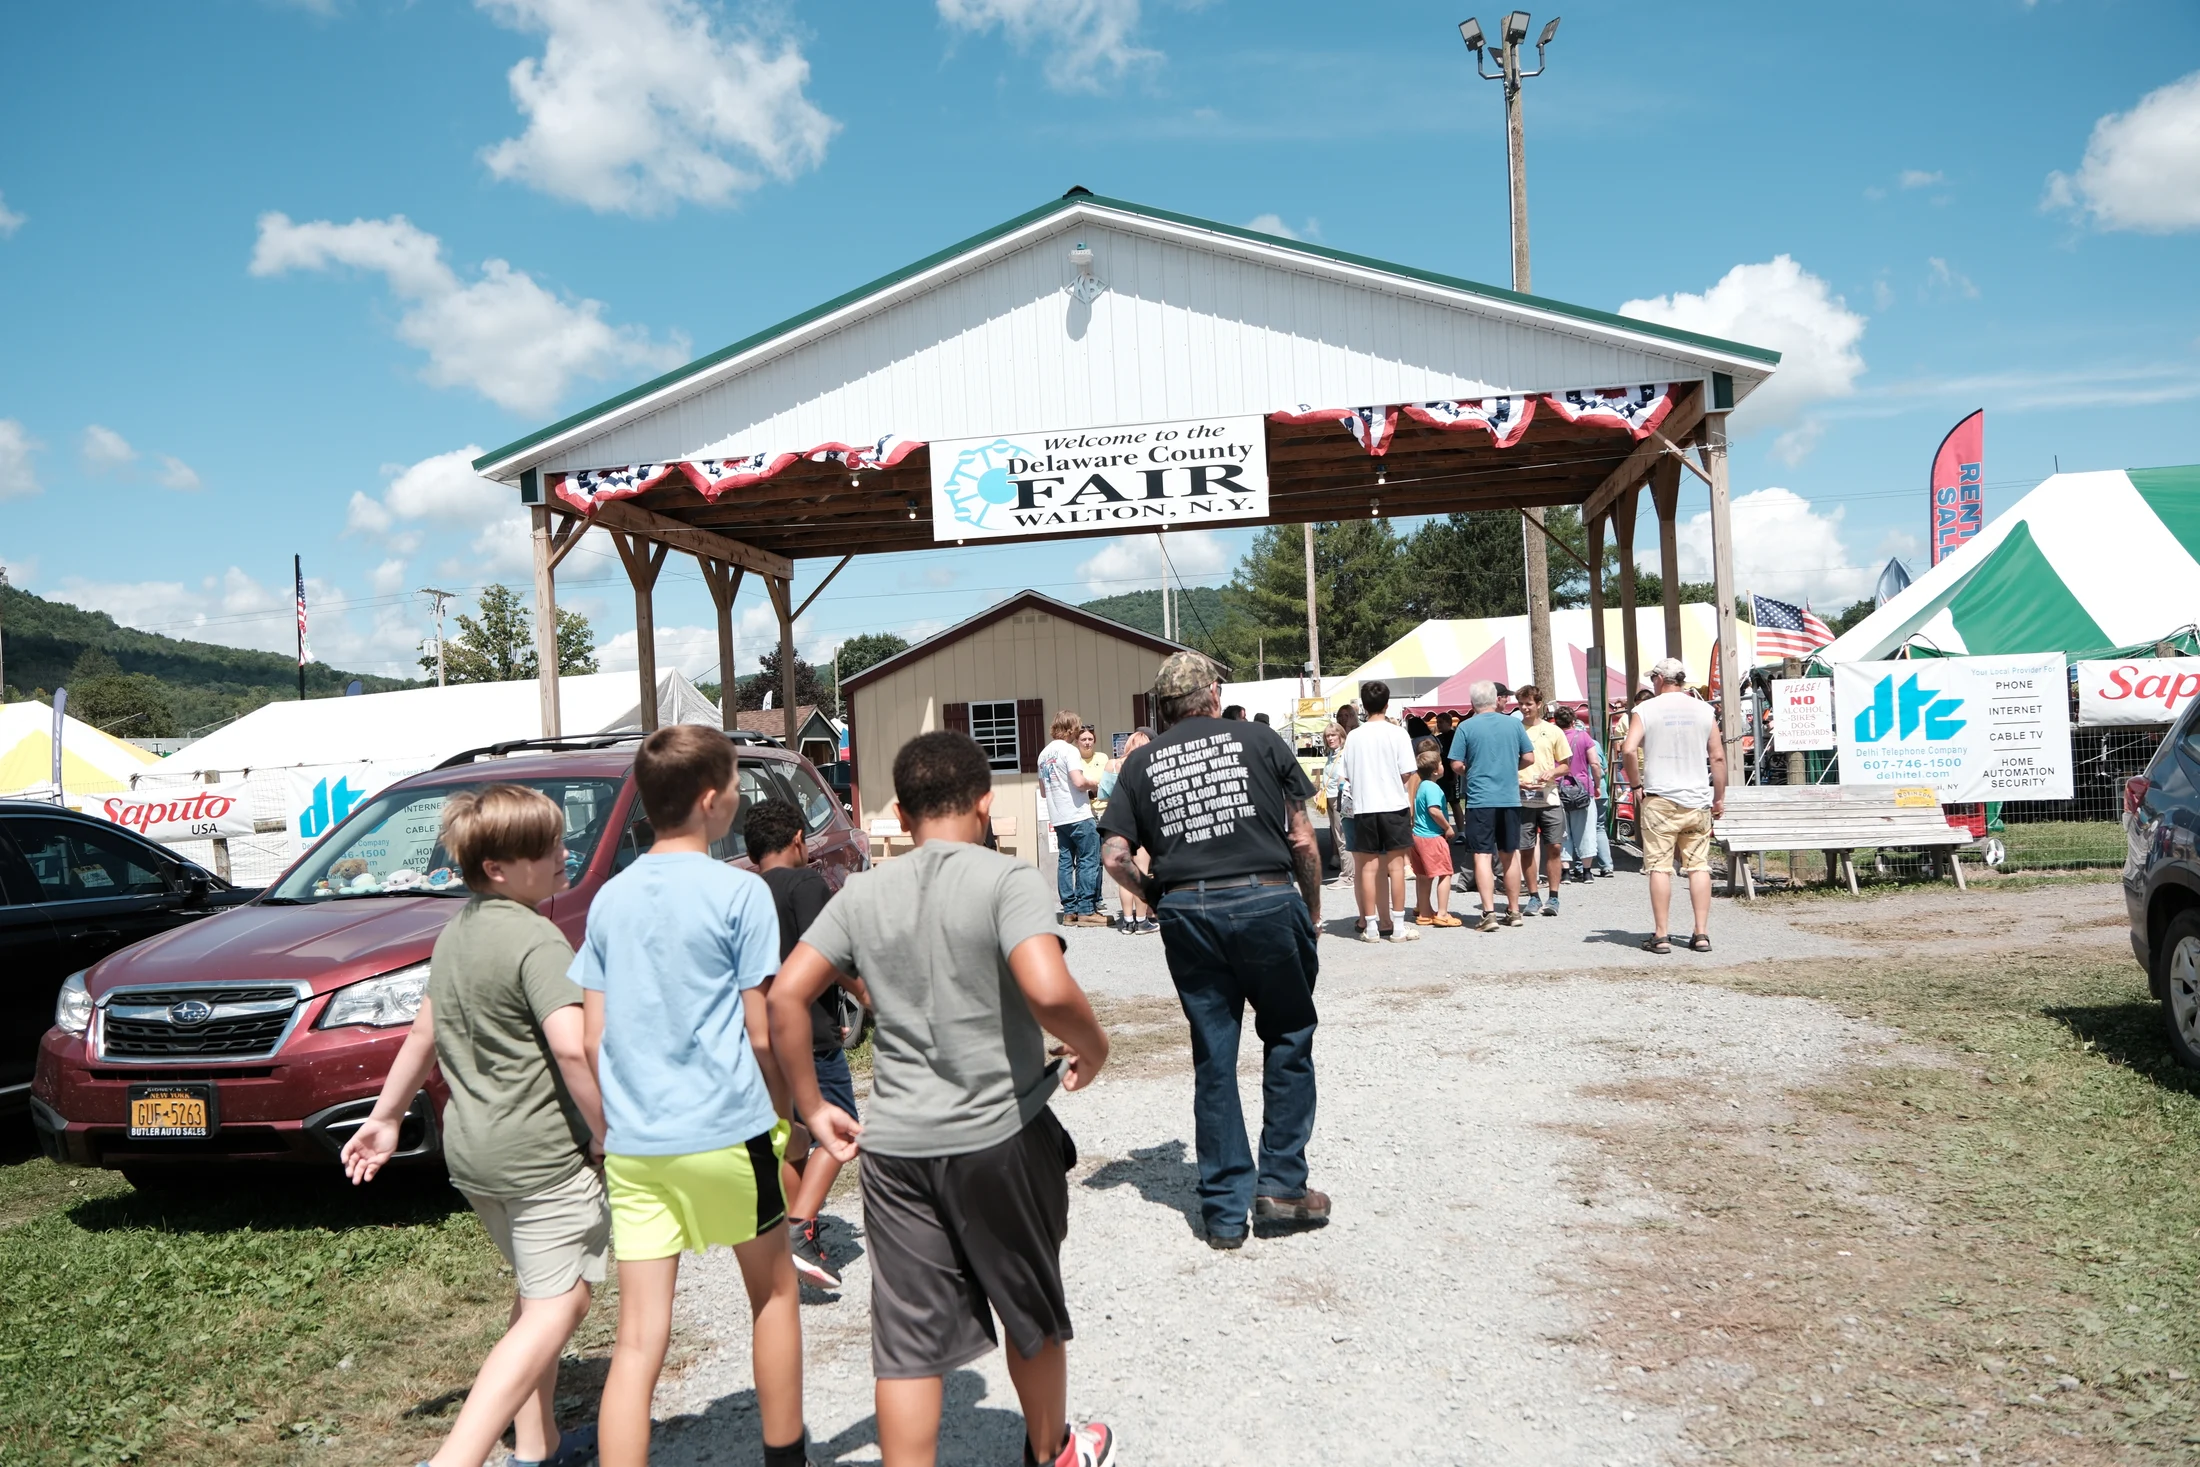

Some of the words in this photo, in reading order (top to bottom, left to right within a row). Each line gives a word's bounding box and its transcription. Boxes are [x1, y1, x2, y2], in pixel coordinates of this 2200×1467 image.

[1044, 432, 1147, 451] Welcome
[1155, 429, 1179, 441] to
[1187, 425, 1226, 439] the
[1007, 453, 1139, 476] Delaware
[1148, 443, 1254, 463] County
[1008, 464, 1256, 511] FAIR
[1013, 504, 1176, 527] WALTON,
[1190, 498, 1254, 514] N.Y.
[2012, 666, 2041, 674] Provider
[2043, 665, 2056, 673] For
[1995, 680, 2033, 690] PHONE
[1790, 695, 1815, 705] NO
[1782, 706, 1824, 714] ALCOHOL
[1989, 705, 2042, 715] INTERNET
[1778, 729, 1830, 737] SKATEBOARDS
[1989, 731, 2026, 741] CABLE
[2030, 731, 2043, 739] TV
[1156, 744, 1183, 760] CAME
[1184, 738, 1208, 752] INTO
[1209, 732, 1232, 746] THIS
[1856, 748, 1879, 757] Delhi
[1881, 747, 1925, 757] Telephone
[1928, 746, 1968, 756] Company
[1145, 757, 1176, 778] WORLD
[1178, 746, 1219, 765] KICKING
[1222, 742, 1243, 754] AND
[1863, 758, 1961, 769] 607-746-1500
[2001, 757, 2033, 766] HOME
[1152, 762, 1207, 788] SCREAMING
[1209, 754, 1240, 770] WHILE
[1876, 770, 1950, 780] delhitel.com
[1982, 767, 2055, 778] AUTOMATION
[1150, 782, 1190, 803] COVERED
[1191, 776, 1203, 788] IN
[1204, 766, 1249, 785] SOMEONE
[1991, 778, 2046, 788] SECURITY
[1158, 794, 1184, 813] ELSES
[1186, 785, 1217, 803] BLOOD
[1220, 780, 1241, 794] AND
[1242, 779, 1248, 791] I
[103, 791, 237, 834] Saputo
[1161, 806, 1187, 824] HAVE
[1188, 802, 1203, 816] NO
[1204, 792, 1249, 812] PROBLEM
[1160, 821, 1183, 838] WITH
[1184, 812, 1214, 830] GOING
[1216, 807, 1235, 820] OUT
[1237, 804, 1256, 818] THE
[191, 823, 218, 835] USA
[405, 825, 435, 834] CABLE
[1184, 829, 1212, 844] SAME
[1213, 821, 1235, 837] WAY
[357, 839, 390, 847] Company
[131, 1127, 160, 1136] BUTLER
[160, 1127, 181, 1136] AUTO
[182, 1127, 207, 1136] SALES
